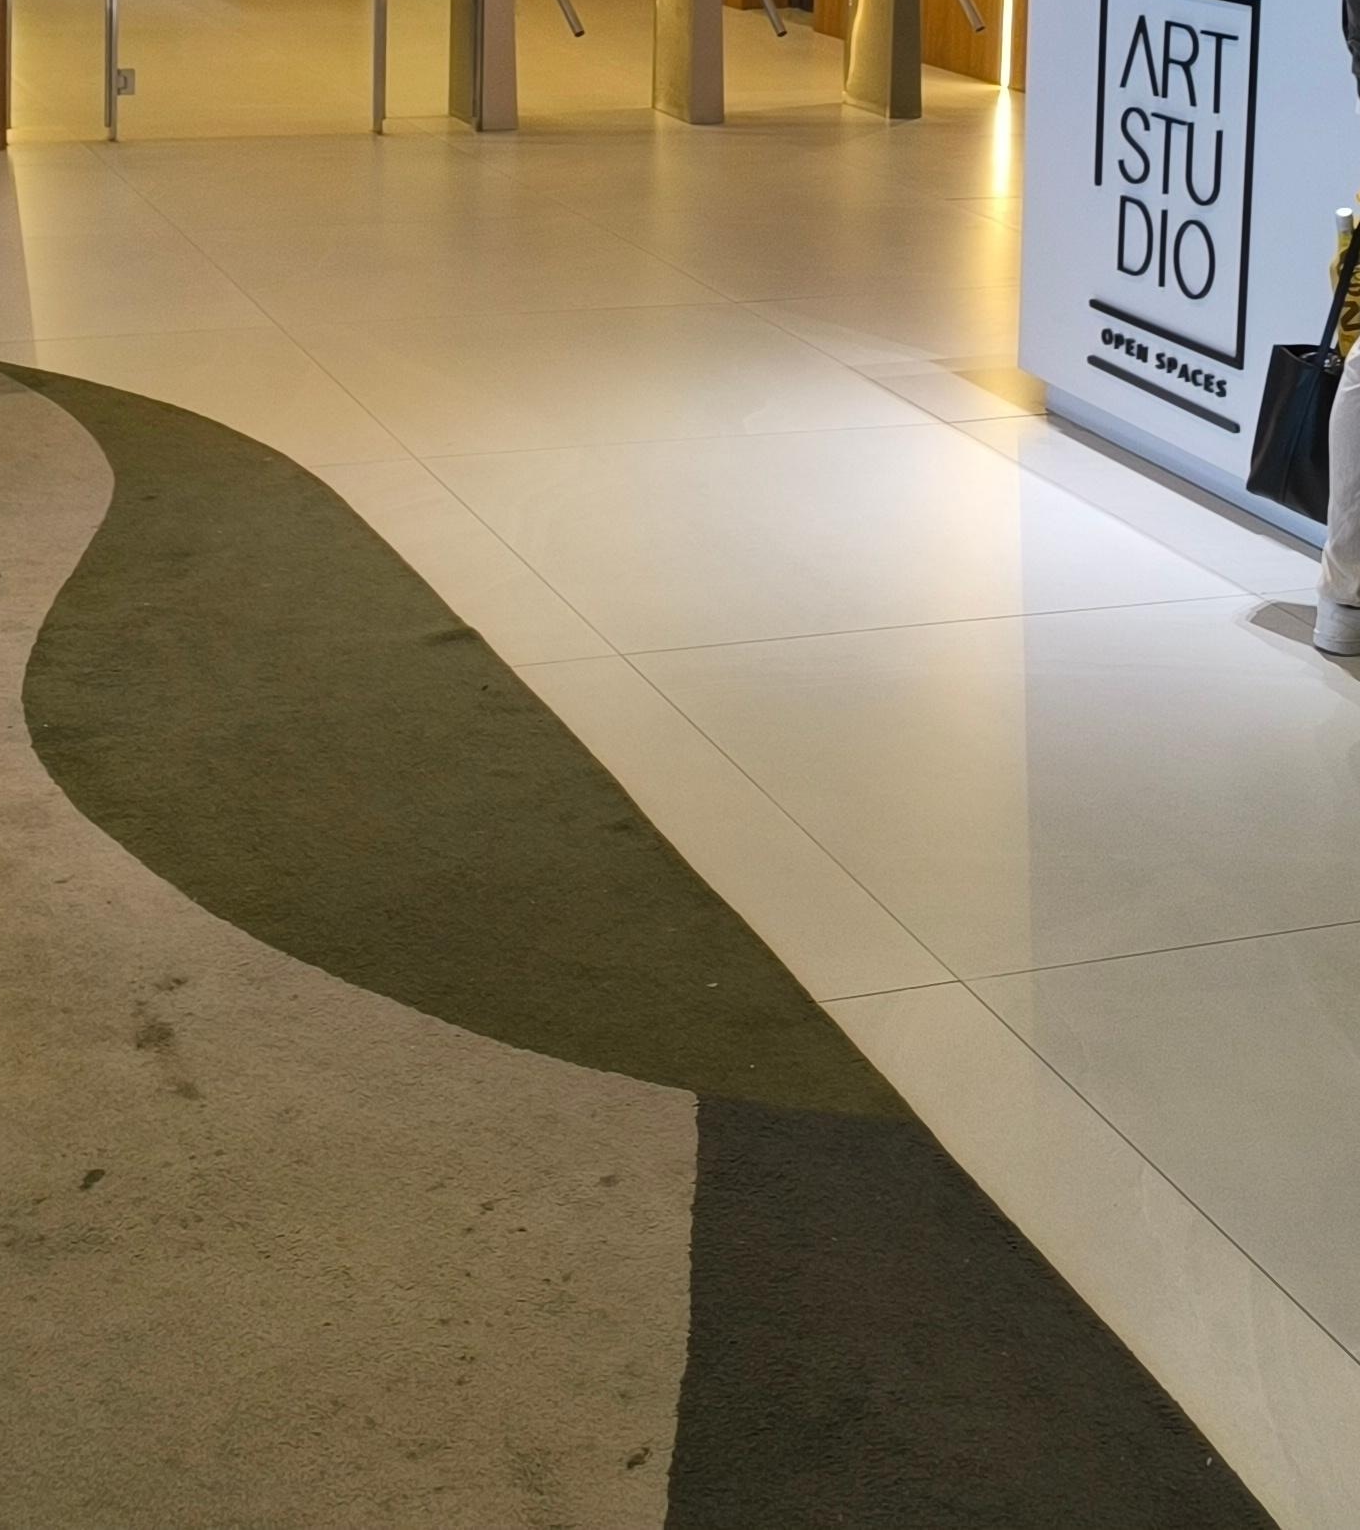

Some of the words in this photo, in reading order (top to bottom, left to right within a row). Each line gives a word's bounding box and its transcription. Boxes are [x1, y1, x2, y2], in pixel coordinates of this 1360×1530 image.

[1119, 15, 1239, 114] ART
[1117, 106, 1224, 207] STU
[1116, 194, 1216, 300] DIO
[1100, 327, 1149, 364] OPEN
[1154, 352, 1228, 399] SPACES
